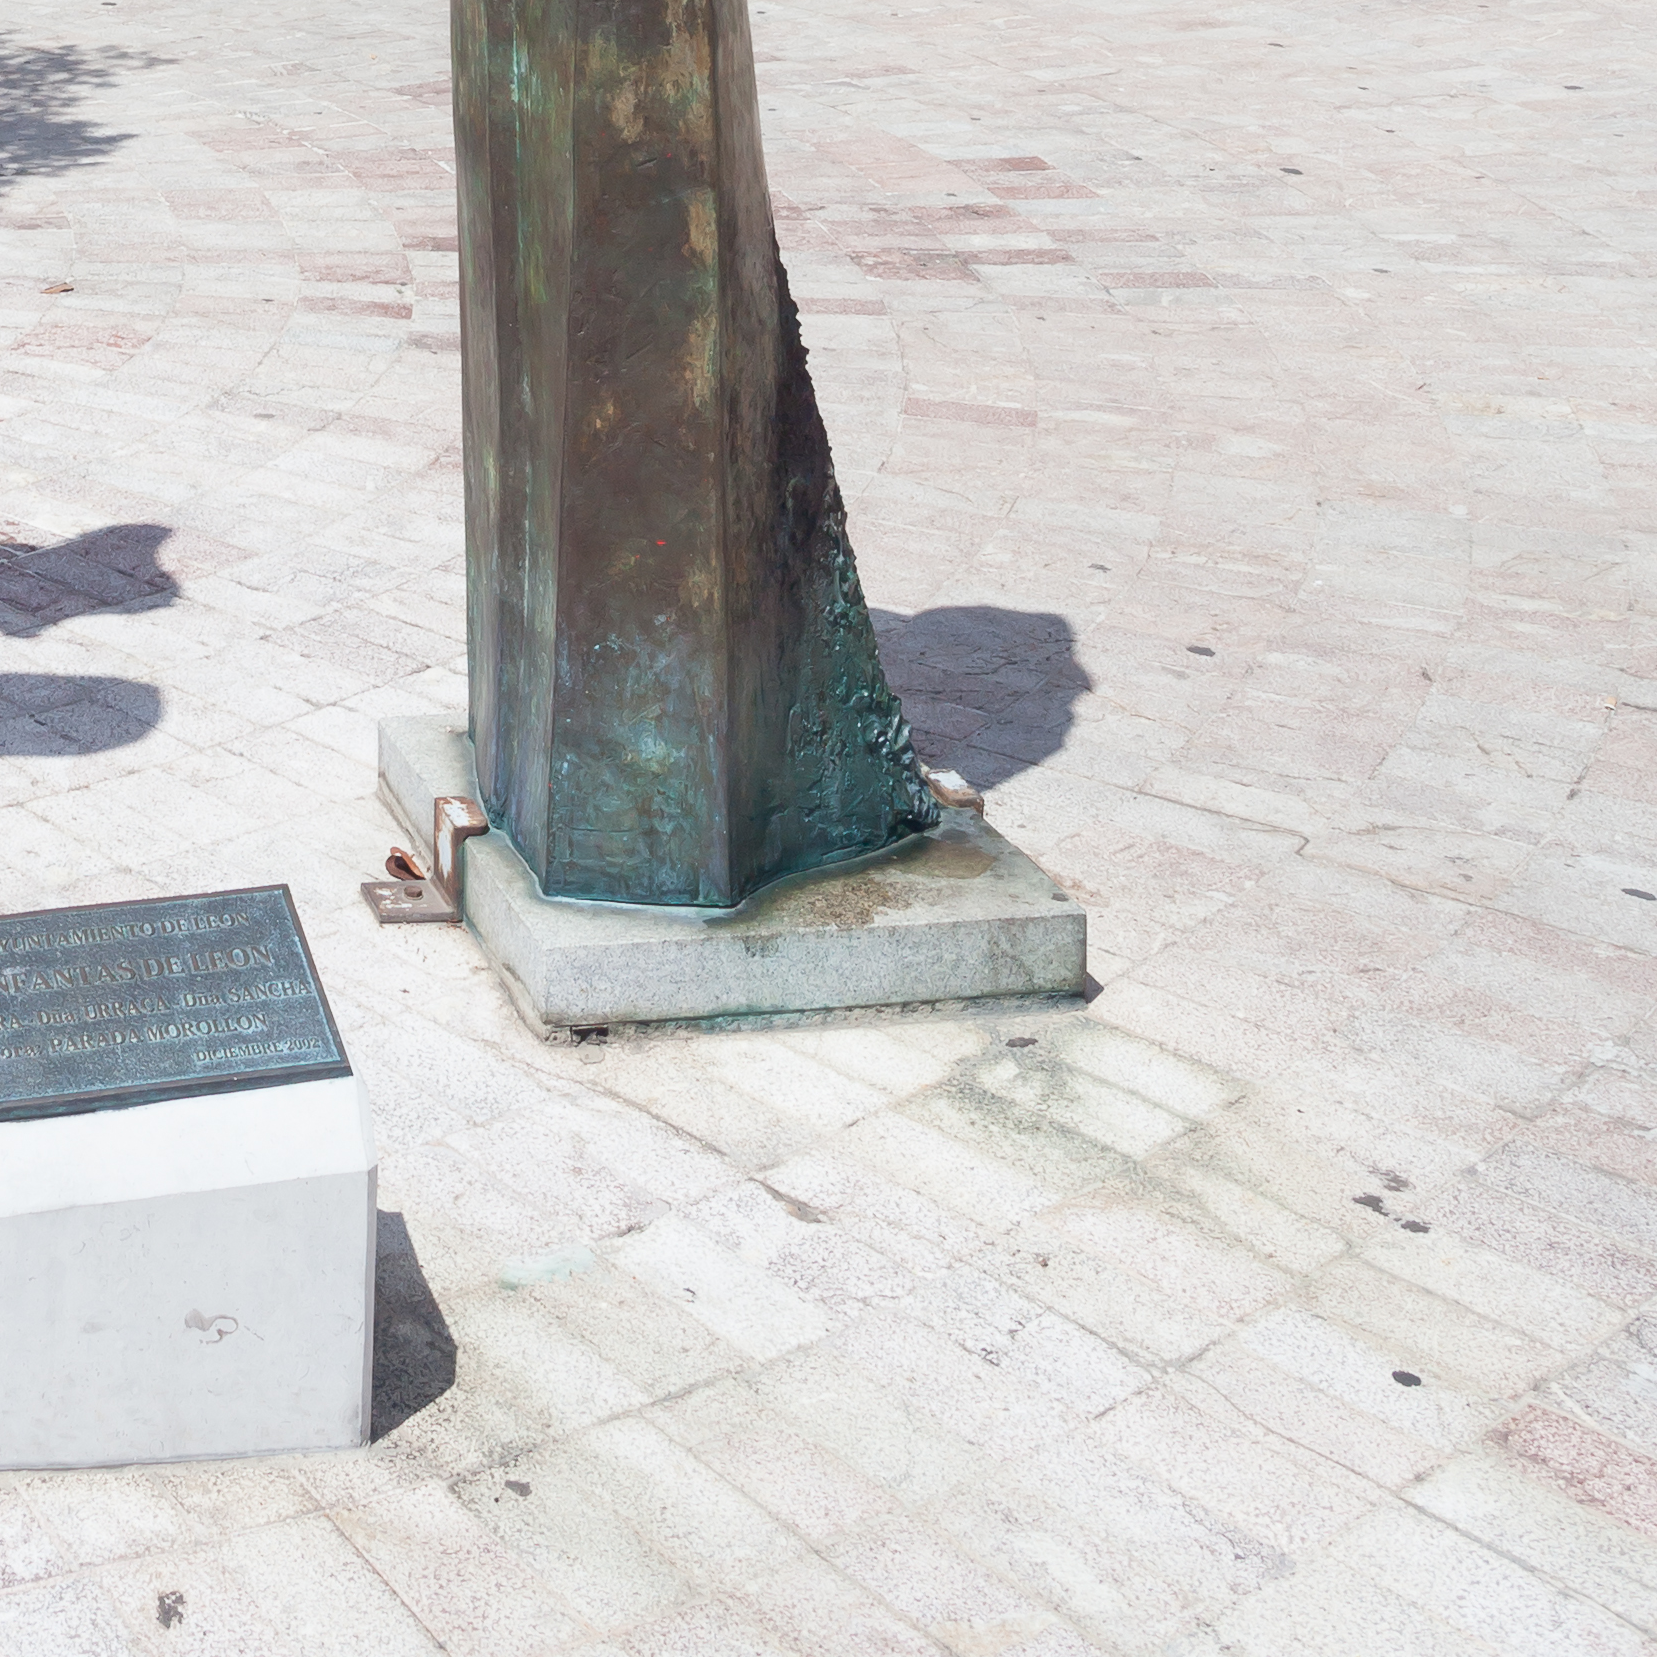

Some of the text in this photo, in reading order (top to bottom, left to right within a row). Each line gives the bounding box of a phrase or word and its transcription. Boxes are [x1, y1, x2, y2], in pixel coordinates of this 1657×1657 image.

[160, 918, 190, 935] DE
[142, 954, 185, 979] DE
[82, 994, 171, 1021] URRACA
[227, 980, 313, 1004] SANCHA
[49, 1029, 144, 1053] PARADA
[194, 1037, 322, 1063] DICIEMBRE 2002
